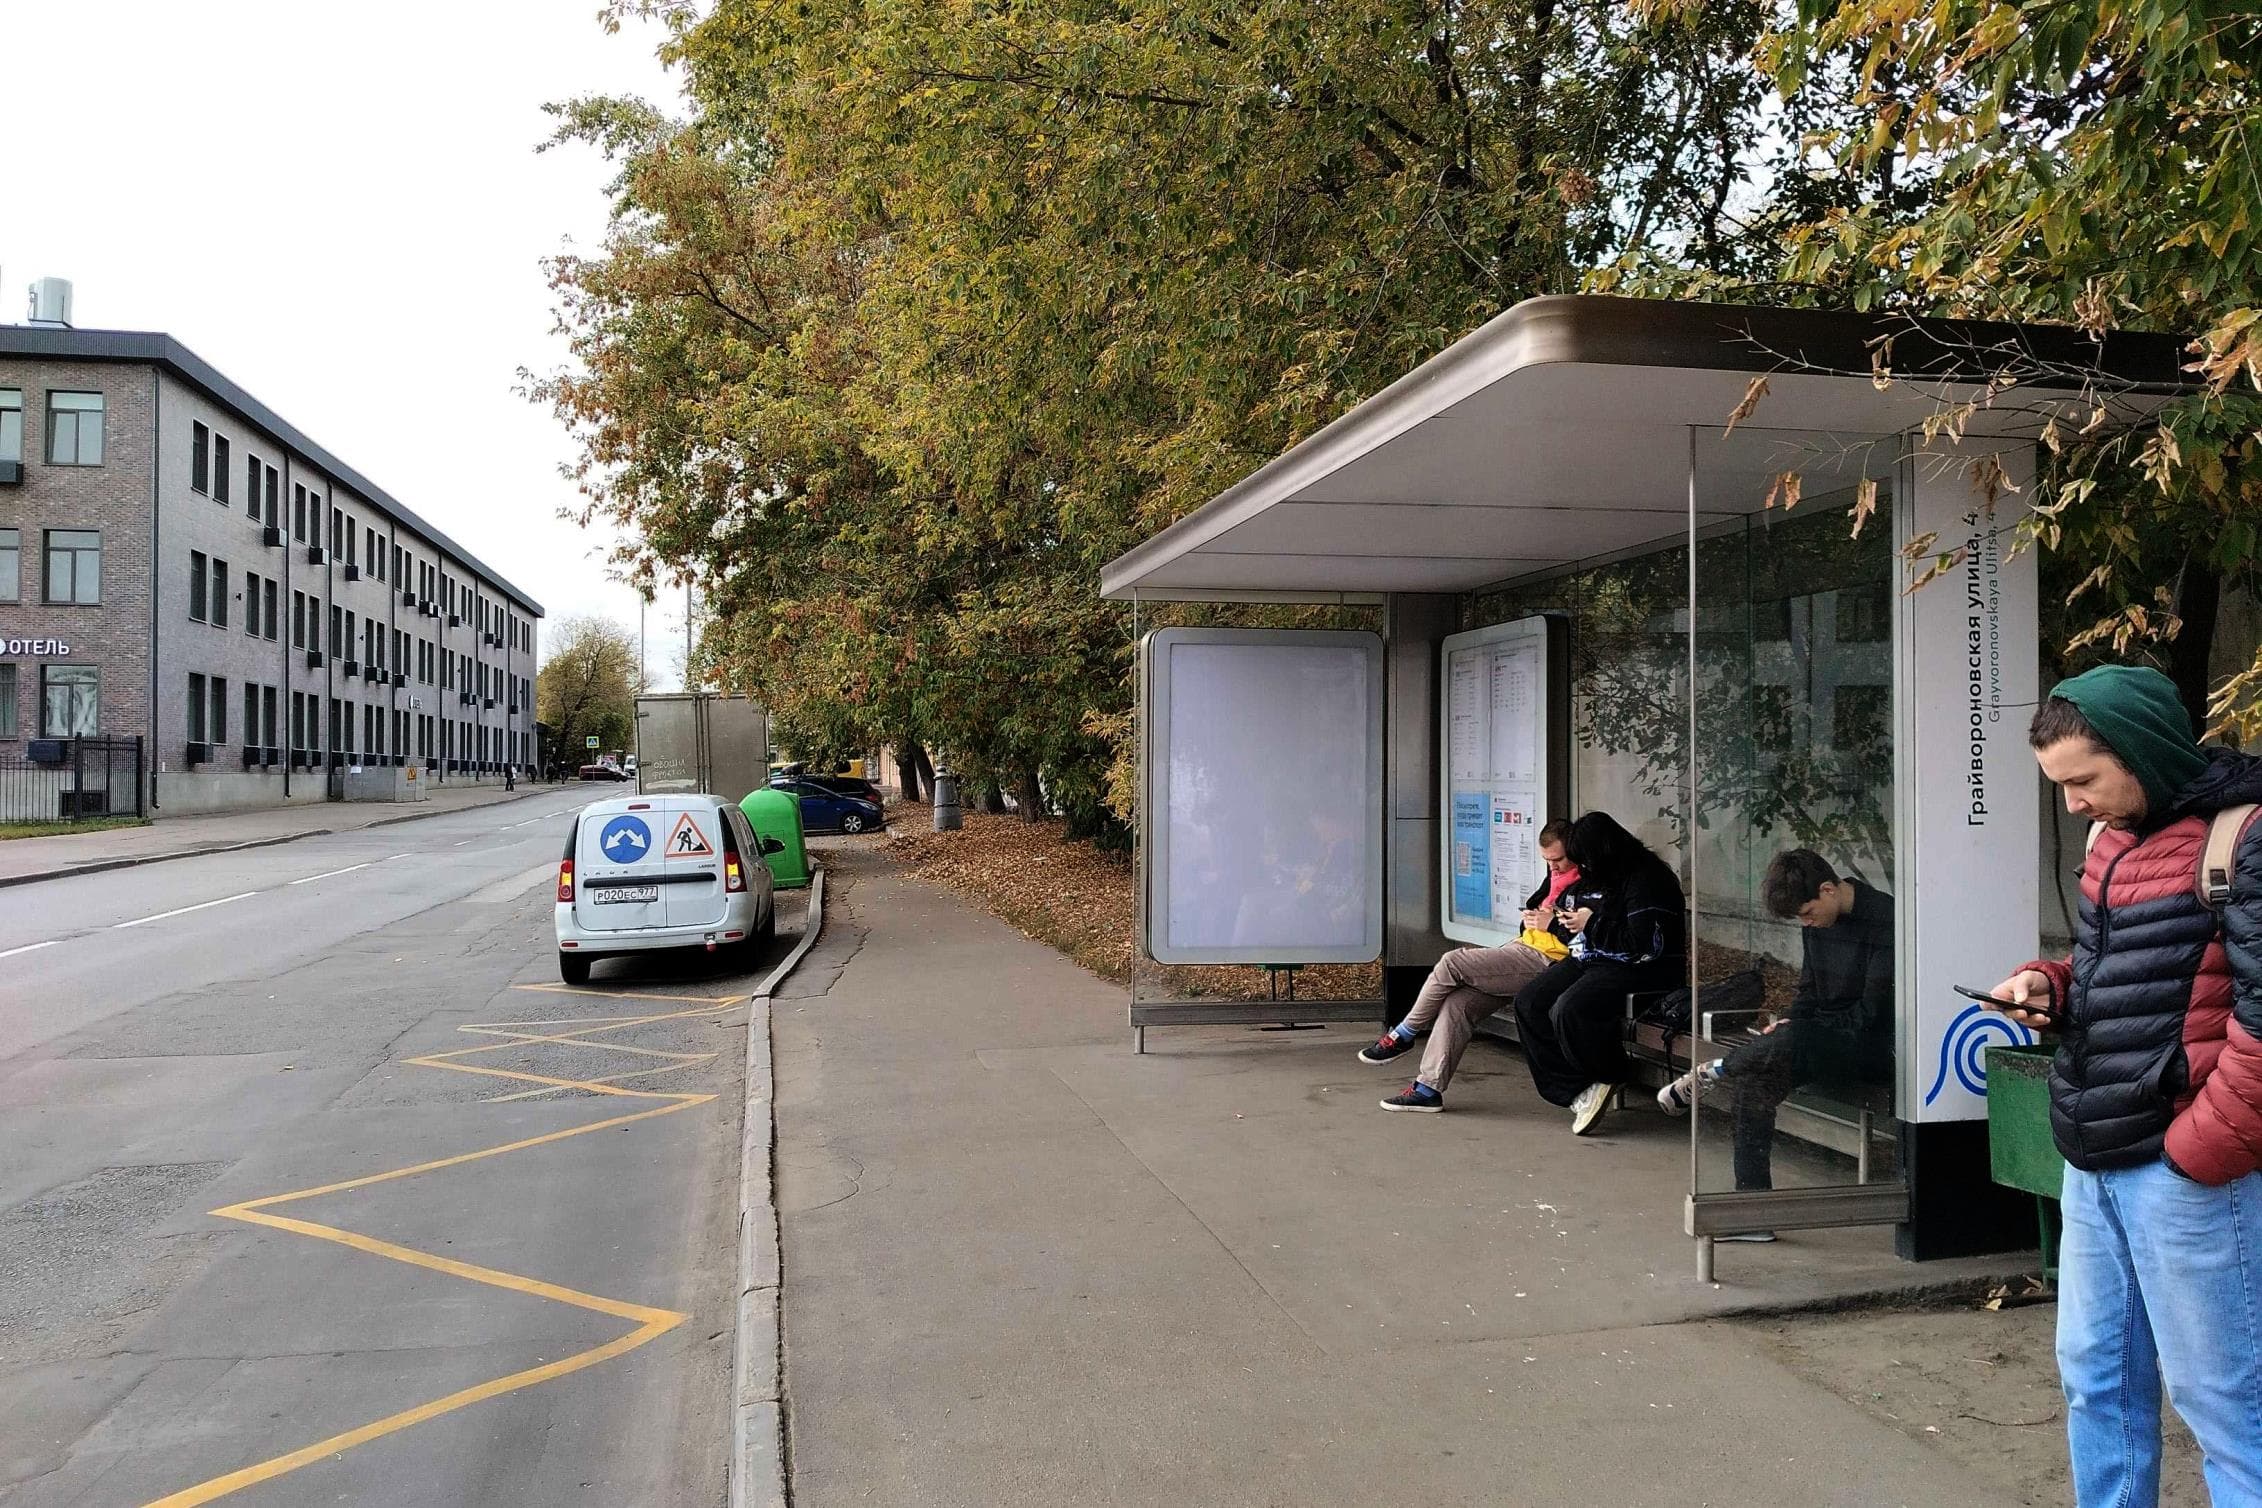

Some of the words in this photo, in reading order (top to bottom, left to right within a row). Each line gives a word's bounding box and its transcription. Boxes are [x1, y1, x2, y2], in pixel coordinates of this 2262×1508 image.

[1961, 511, 1978, 526] 4
[1988, 511, 1997, 521] 4
[1967, 533, 1984, 609] улица,
[1985, 526, 1999, 574] Ulitsa,
[9, 639, 70, 655] ОТЕЛЬ
[1985, 580, 2001, 722] Grayvoronovskaya
[1967, 616, 1988, 825] Грайвороновская
